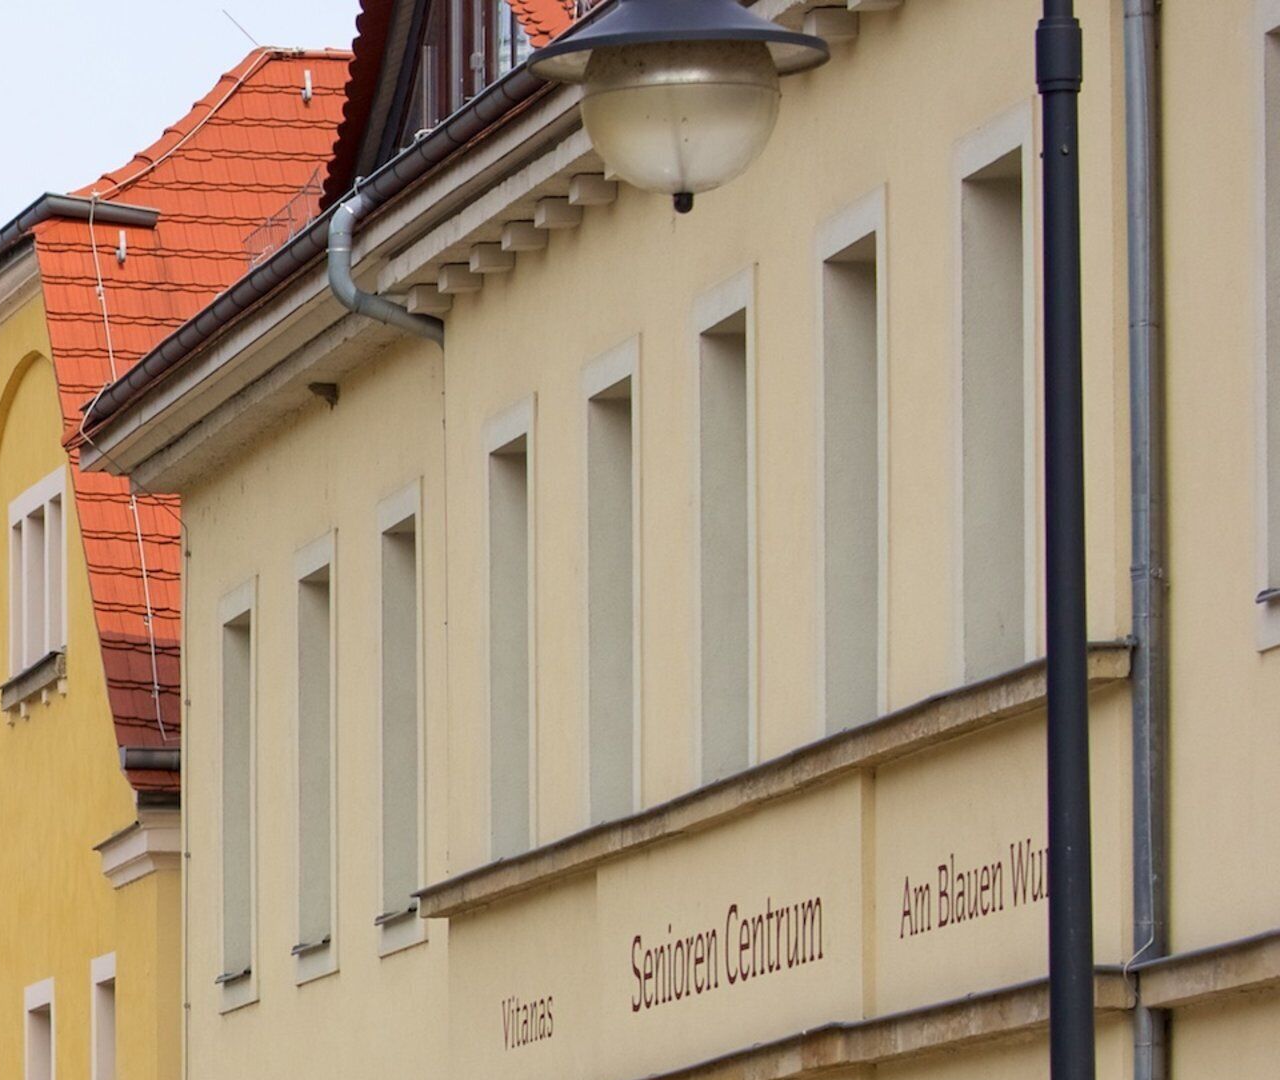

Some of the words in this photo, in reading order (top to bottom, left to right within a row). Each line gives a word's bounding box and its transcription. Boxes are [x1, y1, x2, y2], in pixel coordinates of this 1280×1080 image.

[900, 875, 932, 940] Am
[937, 853, 1005, 929] Blauen
[631, 922, 720, 1013] Senioren
[725, 896, 825, 986] Centrum
[501, 995, 554, 1051] Vitanas
